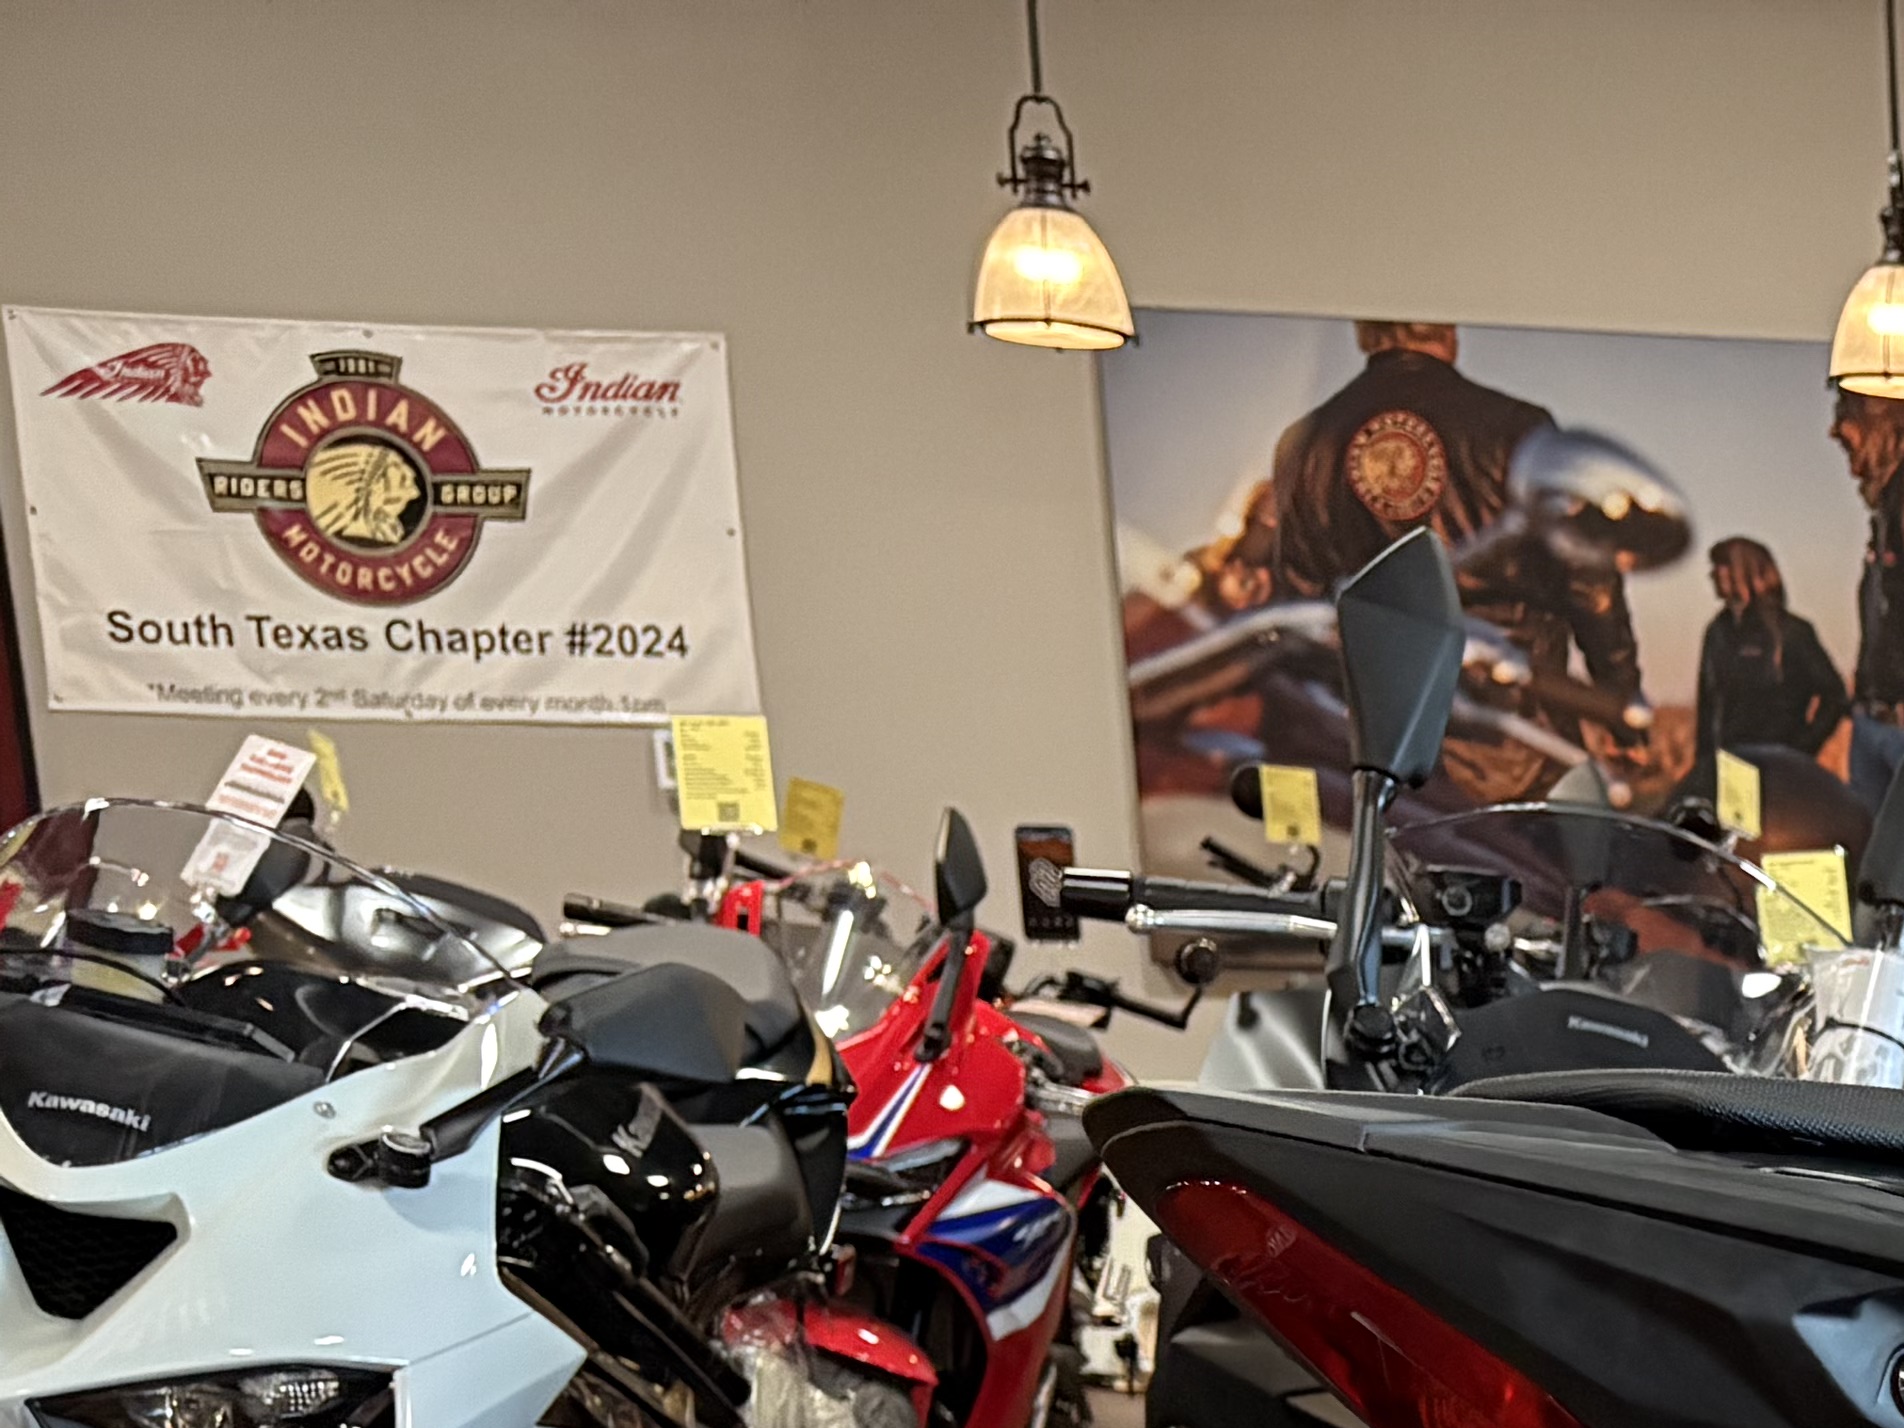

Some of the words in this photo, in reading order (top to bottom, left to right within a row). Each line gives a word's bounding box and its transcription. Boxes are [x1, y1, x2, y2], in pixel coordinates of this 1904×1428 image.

[535, 361, 681, 403] Indian
[280, 383, 445, 454] INDIAN
[214, 475, 304, 499] RIDERS
[440, 484, 518, 505] GROUP
[282, 525, 460, 592] MOTORCYCLE
[107, 611, 235, 649] South
[245, 615, 368, 653] Texas
[384, 619, 553, 662] Chapter
[564, 622, 690, 660] #2024
[1567, 1015, 1649, 1049] Kawasaki
[27, 1090, 152, 1133] Kawasaki
